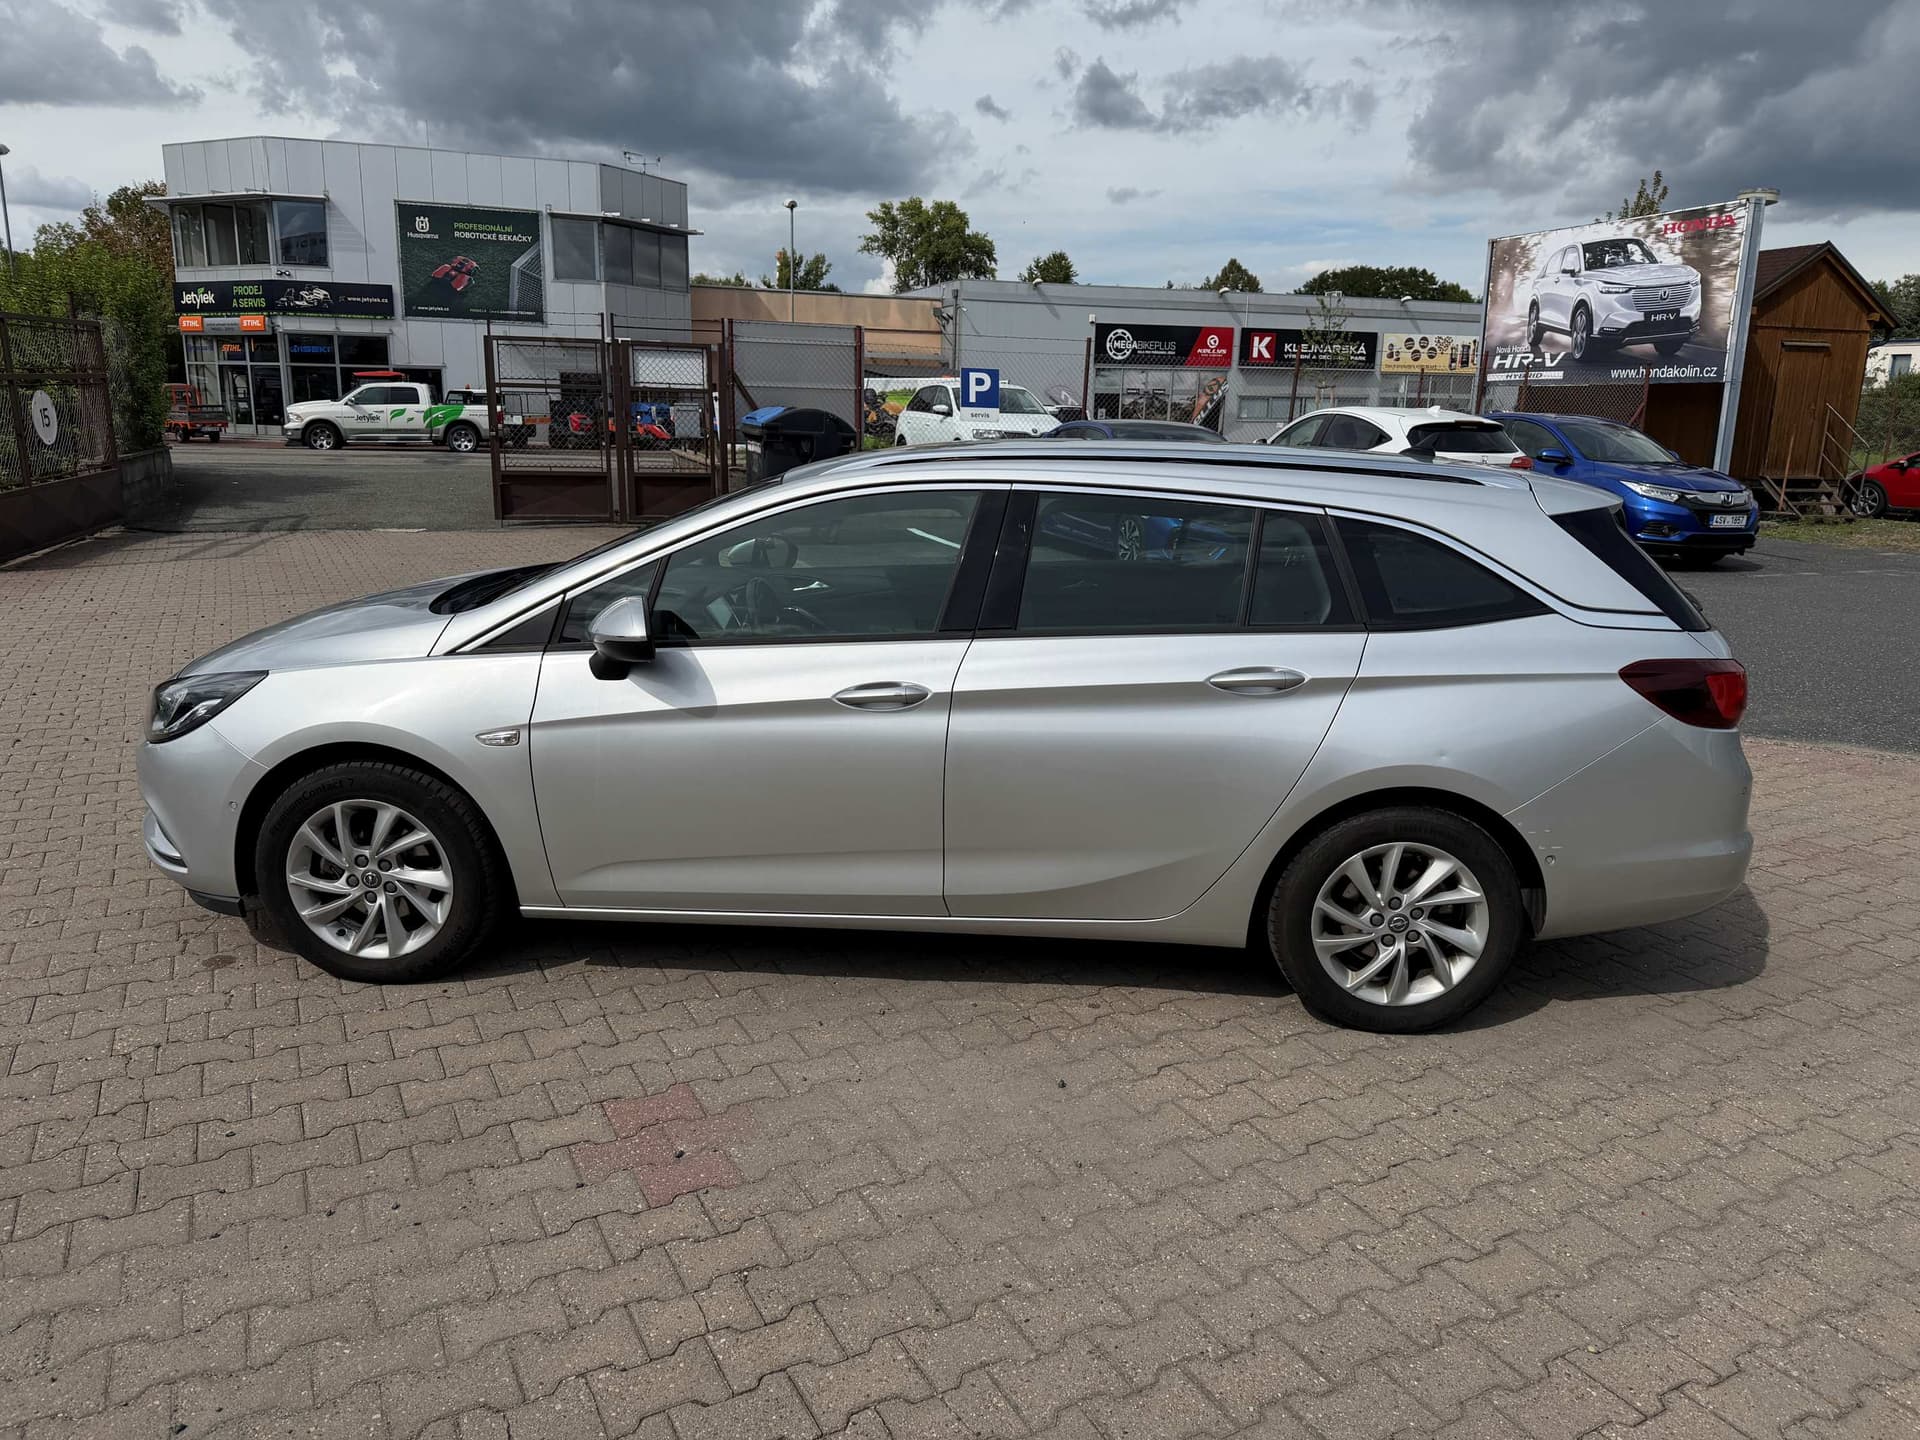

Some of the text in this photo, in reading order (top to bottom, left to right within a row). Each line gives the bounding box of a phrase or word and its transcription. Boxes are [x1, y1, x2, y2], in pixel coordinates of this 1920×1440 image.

[1663, 214, 1737, 235] HONDA
[407, 231, 439, 240] Husqvarna
[454, 231, 533, 243] ROBOTICKÉ SEKAČKY
[233, 285, 263, 296] PRODEJ
[232, 298, 266, 308] A SERVIS
[1651, 312, 1677, 322] HR-V
[242, 319, 261, 327] STIHL
[221, 344, 242, 352] STIHL
[1252, 336, 1273, 358] K
[1496, 346, 1511, 354] Nová
[1492, 352, 1567, 369] HR-V
[968, 371, 992, 403] P
[40, 407, 51, 428] 15
